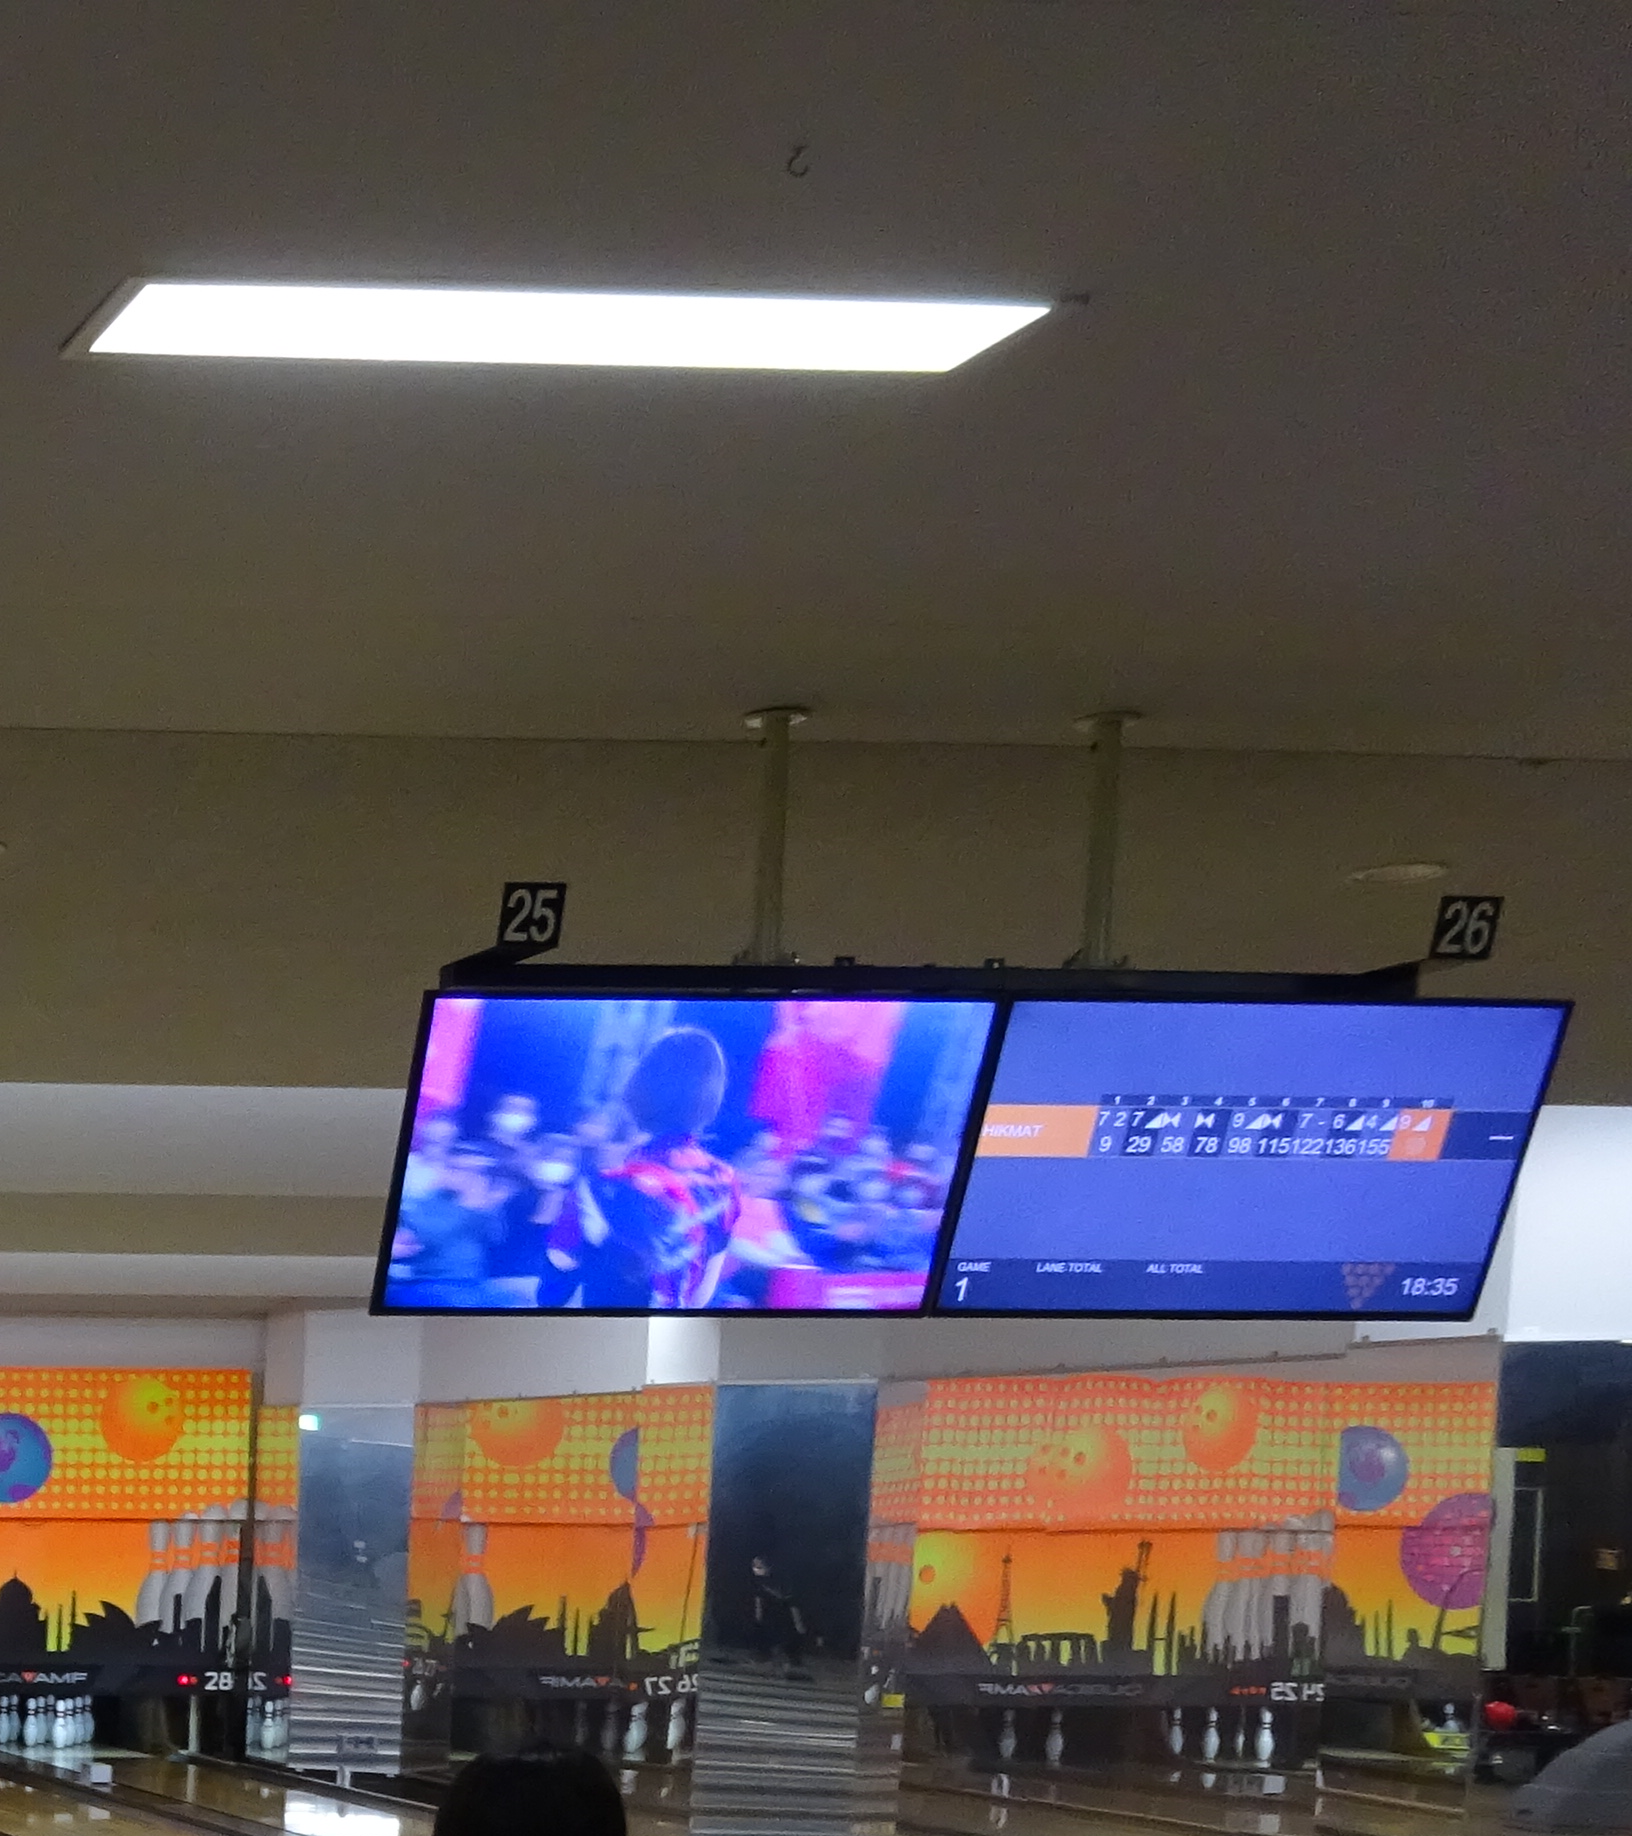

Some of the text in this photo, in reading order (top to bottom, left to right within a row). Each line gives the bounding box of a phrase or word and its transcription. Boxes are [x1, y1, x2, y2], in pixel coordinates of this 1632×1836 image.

[501, 888, 559, 944] 25
[1436, 900, 1495, 955] 26
[982, 1124, 1043, 1138] HIKMAT
[1099, 1136, 1391, 1155] 9 29 58 78 98 115 122 136 155
[956, 1262, 1204, 1274] GAME LANE TOTAL ALL TOTAL
[955, 1277, 1460, 1302] 1 18:35
[204, 1671, 235, 1691] 28
